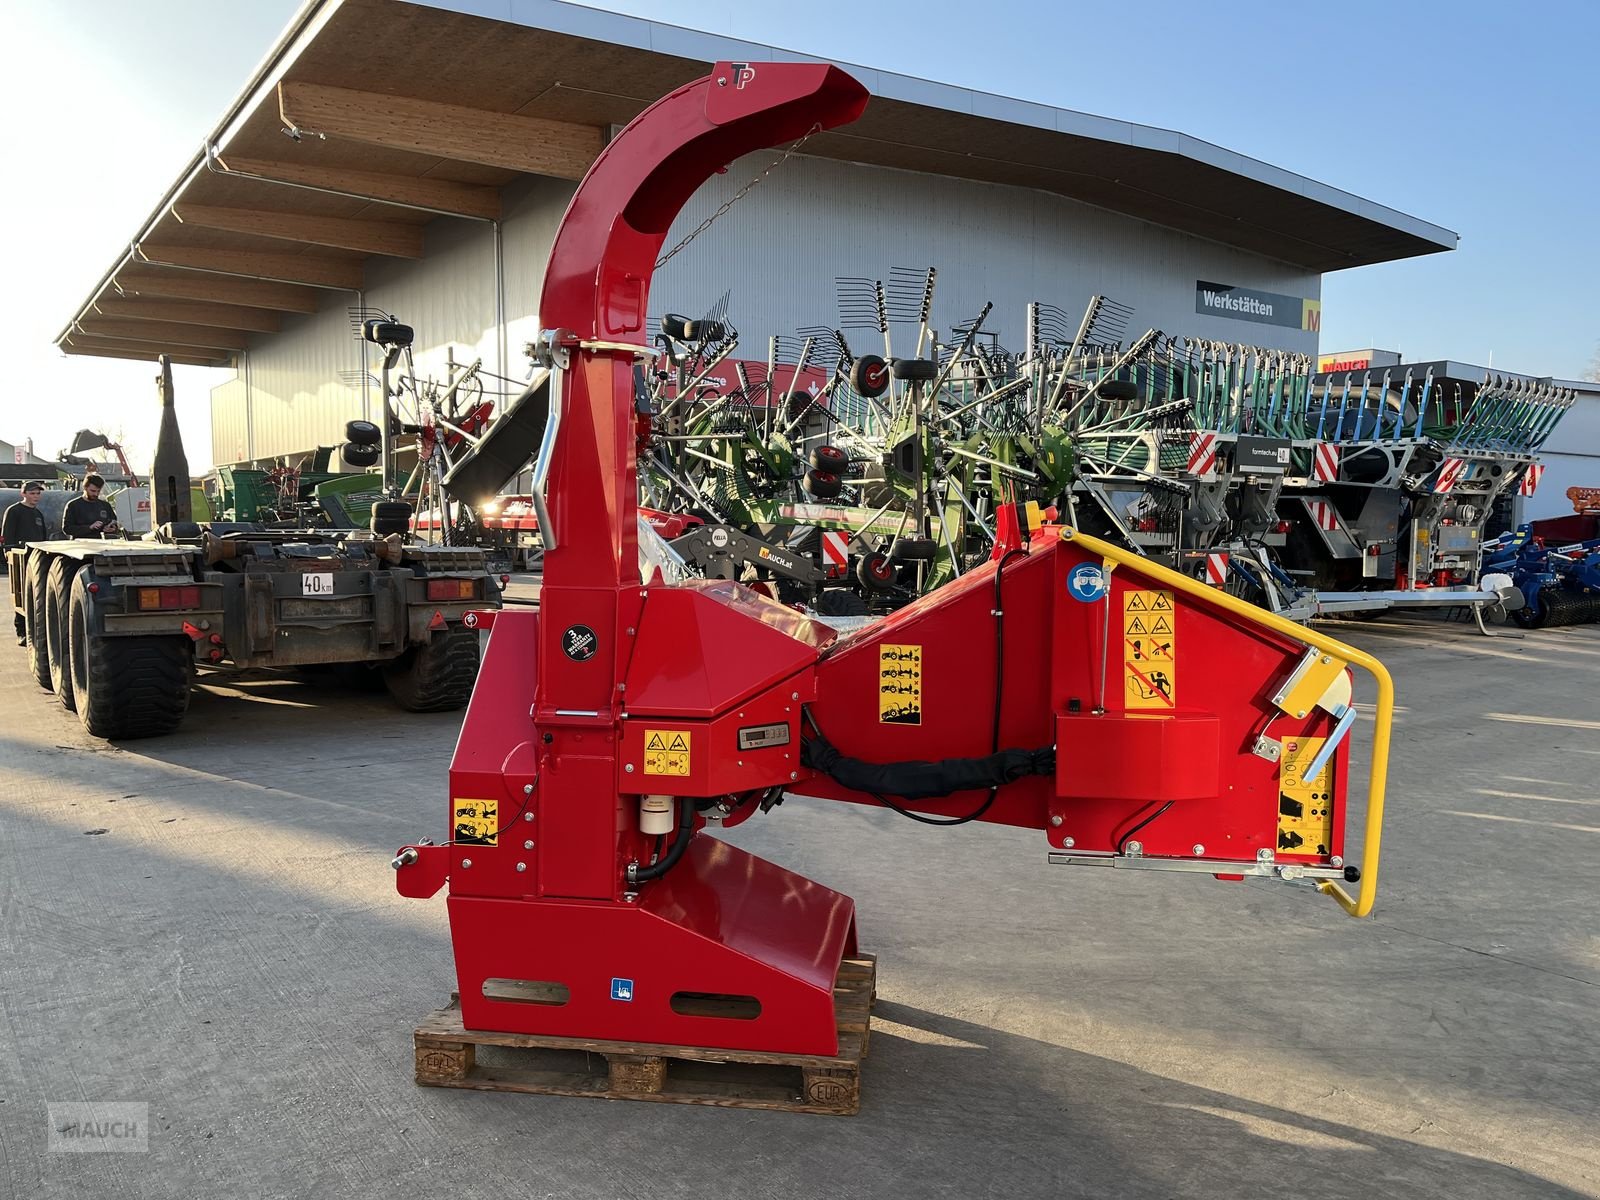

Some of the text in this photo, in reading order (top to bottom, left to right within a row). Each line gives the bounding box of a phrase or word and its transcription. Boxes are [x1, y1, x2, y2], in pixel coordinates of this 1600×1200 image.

[1203, 290, 1273, 316] Werkstätten
[1322, 360, 1369, 372] MAUCH
[1252, 447, 1278, 456] formtech.eu
[759, 547, 793, 569] MAUCH.at
[304, 576, 332, 592] 40 km
[567, 633, 591, 652] WARRANTY
[568, 630, 577, 639] 3
[817, 1085, 840, 1101] EUR
